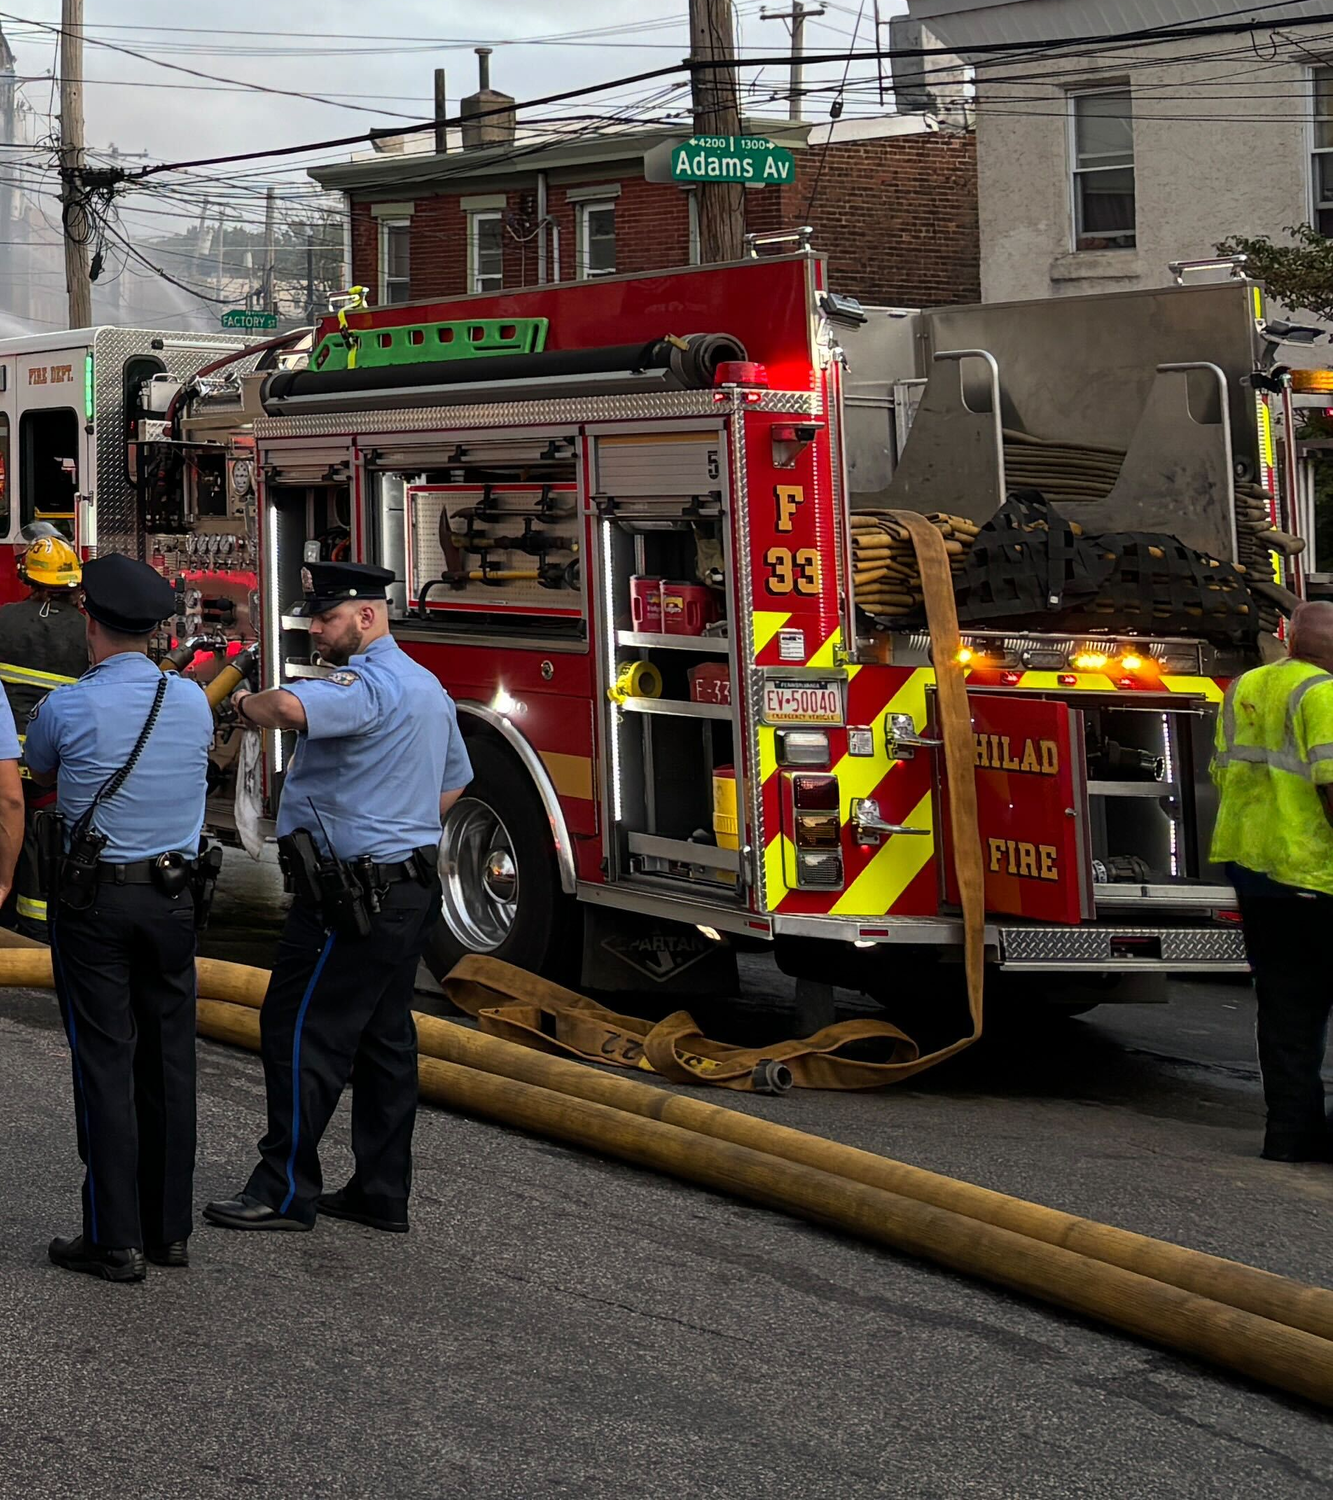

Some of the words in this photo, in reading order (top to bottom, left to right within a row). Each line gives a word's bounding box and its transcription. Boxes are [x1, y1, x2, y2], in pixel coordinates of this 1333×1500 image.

[698, 138, 726, 148] 4200
[741, 140, 766, 150] 1300
[675, 150, 753, 177] Adams
[763, 156, 790, 179] Av
[223, 315, 265, 327] FACTORY
[28, 366, 47, 385] FIRE
[50, 364, 74, 384] DEPT.
[707, 450, 719, 480] 5
[775, 485, 804, 532] F
[764, 547, 822, 595] 33
[973, 733, 1058, 775] HILAD
[988, 837, 1059, 881] FIRE
